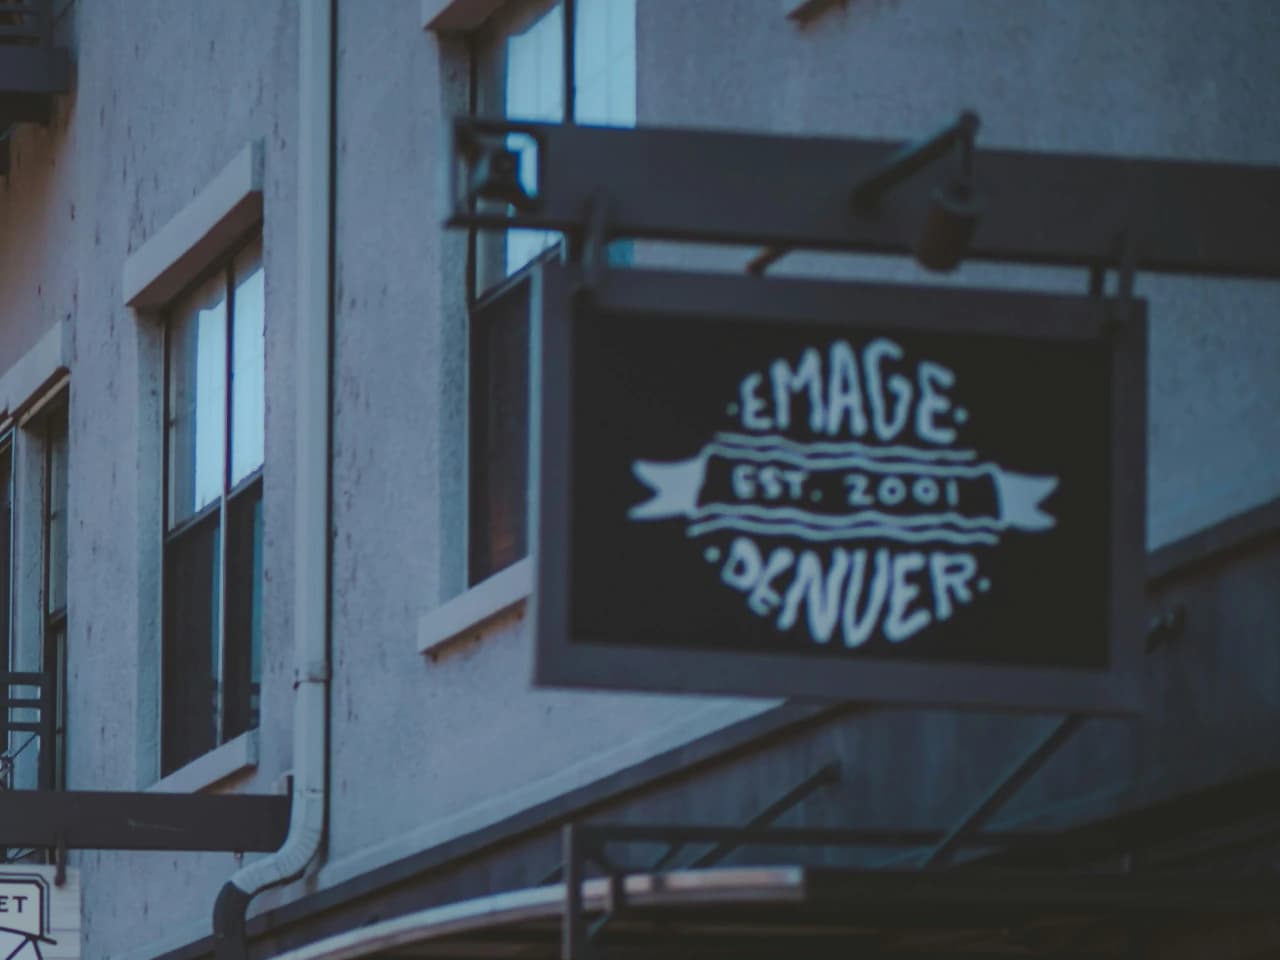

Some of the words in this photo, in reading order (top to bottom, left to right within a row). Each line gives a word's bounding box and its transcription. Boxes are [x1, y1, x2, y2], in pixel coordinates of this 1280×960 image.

[740, 338, 957, 443] EMAGE
[732, 463, 822, 502] EST.
[844, 474, 961, 507] 2001
[721, 538, 978, 648] DENVER
